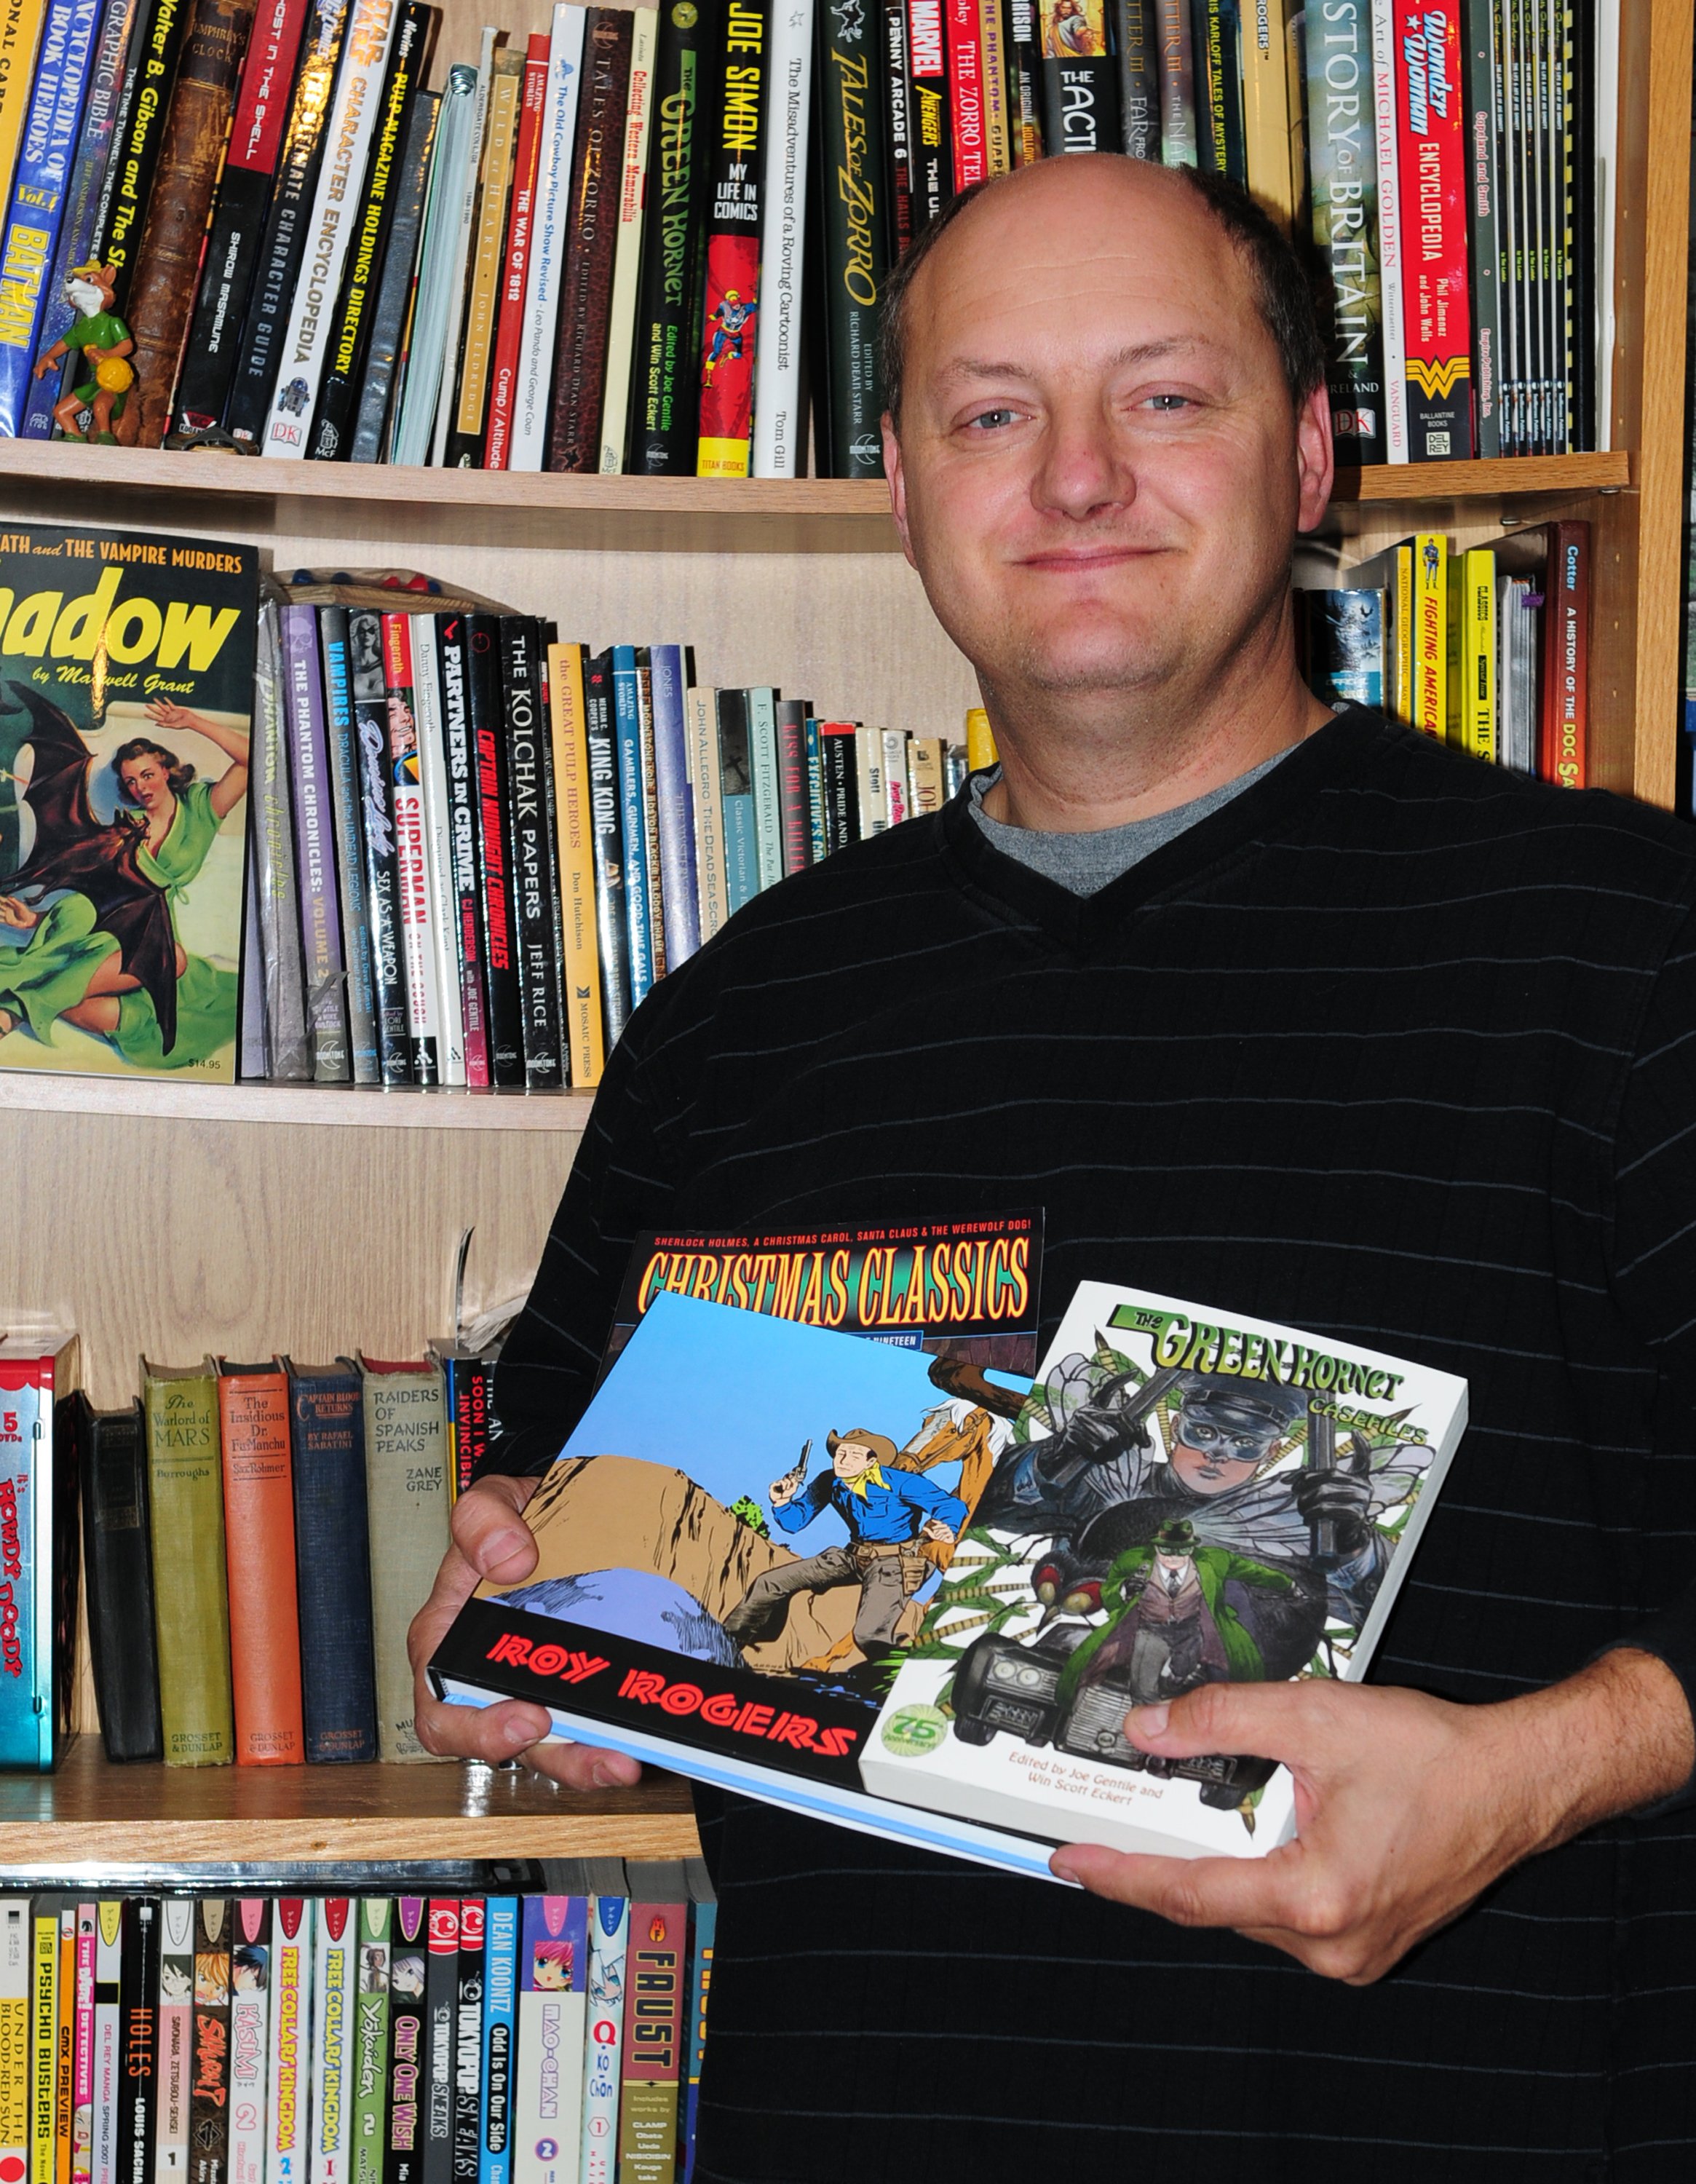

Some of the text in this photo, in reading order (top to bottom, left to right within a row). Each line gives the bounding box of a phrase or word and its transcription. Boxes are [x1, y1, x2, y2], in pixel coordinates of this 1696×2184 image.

[911, 0, 941, 75] MARVEL
[25, 4, 72, 164] BOOK HEROES
[87, 1, 127, 140] GRAPHIC BIBLE
[721, 2, 764, 151] JOE SIMON
[986, 32, 1001, 111] PHANTOM
[1209, 17, 1227, 173] KARLOFF TALES OF MYSTERY
[887, 17, 908, 187] PENNY ARCADE 6 THE
[1403, 10, 1454, 261] Wonder Woman ENCYCLOPEDIA
[335, 19, 417, 375] Nevins PULP MAGAZINE HOLDINGS DIRECTORY
[714, 163, 758, 221] MY LIFE IN COMICS
[1323, 1, 1368, 365] STORY OF BRITAIN
[508, 189, 531, 301] THE WAR OF 1812
[0, 223, 50, 348] BATMAN
[208, 232, 242, 354] SHIROW MASAMUNE
[248, 209, 297, 377] CHARACTER GUIDE
[1419, 275, 1433, 342] and John Wells
[1436, 278, 1449, 337] Phil Jimenez
[650, 344, 661, 364] Win
[651, 323, 662, 343] and
[649, 365, 661, 395] Scott
[660, 325, 678, 432] Edited by Joe Gentile
[274, 424, 299, 443] DK
[489, 368, 512, 470] Crump Altitude
[646, 397, 659, 431] Eckert
[774, 411, 787, 469] Tom Gill
[1390, 380, 1402, 447] VANGUARD
[702, 459, 745, 471] TITAN BOOKS
[0, 534, 242, 574] ATH and THE VAMPIRE MURDERS
[1400, 616, 1408, 678] GEOGRAPHIC
[1424, 596, 1438, 740] FIGHTING AMERICAN
[662, 664, 673, 699] JONES
[559, 659, 583, 951] the GREAT PULP HEROES Don Hutchison
[834, 738, 848, 846] AUSTEN PRIDE AND
[477, 729, 510, 970] CAPTAIN MIDNIGHT CHRONICLES
[511, 636, 547, 1028] THE KOLCHAK PAPERS JEFF RICE
[395, 797, 427, 925] SUPERMAN
[579, 1002, 593, 1078] MOSAIC PRESS
[654, 1218, 1031, 1249] SHERLOCK HOLMES, A CHRISTMAS CAROL, SANTA CLAUS & THE WEREWOLF DOG!
[638, 1236, 1031, 1326] CHRISTMAS CLASSICS
[4, 1412, 17, 1432] 5
[154, 1409, 210, 1427] Warlord of
[230, 1410, 285, 1423] Insidious
[244, 1397, 268, 1409] The
[373, 1388, 439, 1405] RAIDERS
[375, 1407, 396, 1421] OF
[1308, 1397, 1428, 1447] CASEFILES
[155, 1428, 210, 1447] MARS
[375, 1421, 439, 1436] SPANISH
[376, 1439, 425, 1453] PEAKS
[156, 1468, 209, 1481] Burroughs
[406, 1467, 442, 1480] ZANE
[406, 1479, 443, 1492] GREY
[0, 1479, 23, 1678] HOWDY DOODY
[486, 1631, 858, 1757] ROY ROGERS
[172, 1732, 221, 1743] GROSSET
[892, 1712, 943, 1738] 75
[1009, 1751, 1164, 1799] Edited by Joe Gentile and
[1028, 1771, 1133, 1805] Win Scott Eckert
[493, 1912, 513, 1951] DEAN
[491, 1957, 512, 2013] KOONTZ
[632, 1950, 677, 2069] FAUST
[492, 2027, 507, 2053] Odd
[593, 2020, 616, 2046] Q
[13, 2003, 24, 2145] UNDER THE
[392, 2015, 420, 2151] ONLY ONE WISH
[491, 2073, 507, 2091] On
[492, 2057, 507, 2070] Is
[590, 2078, 612, 2098] Chan
[491, 2095, 506, 2118] Our
[490, 2122, 504, 2151] Side
